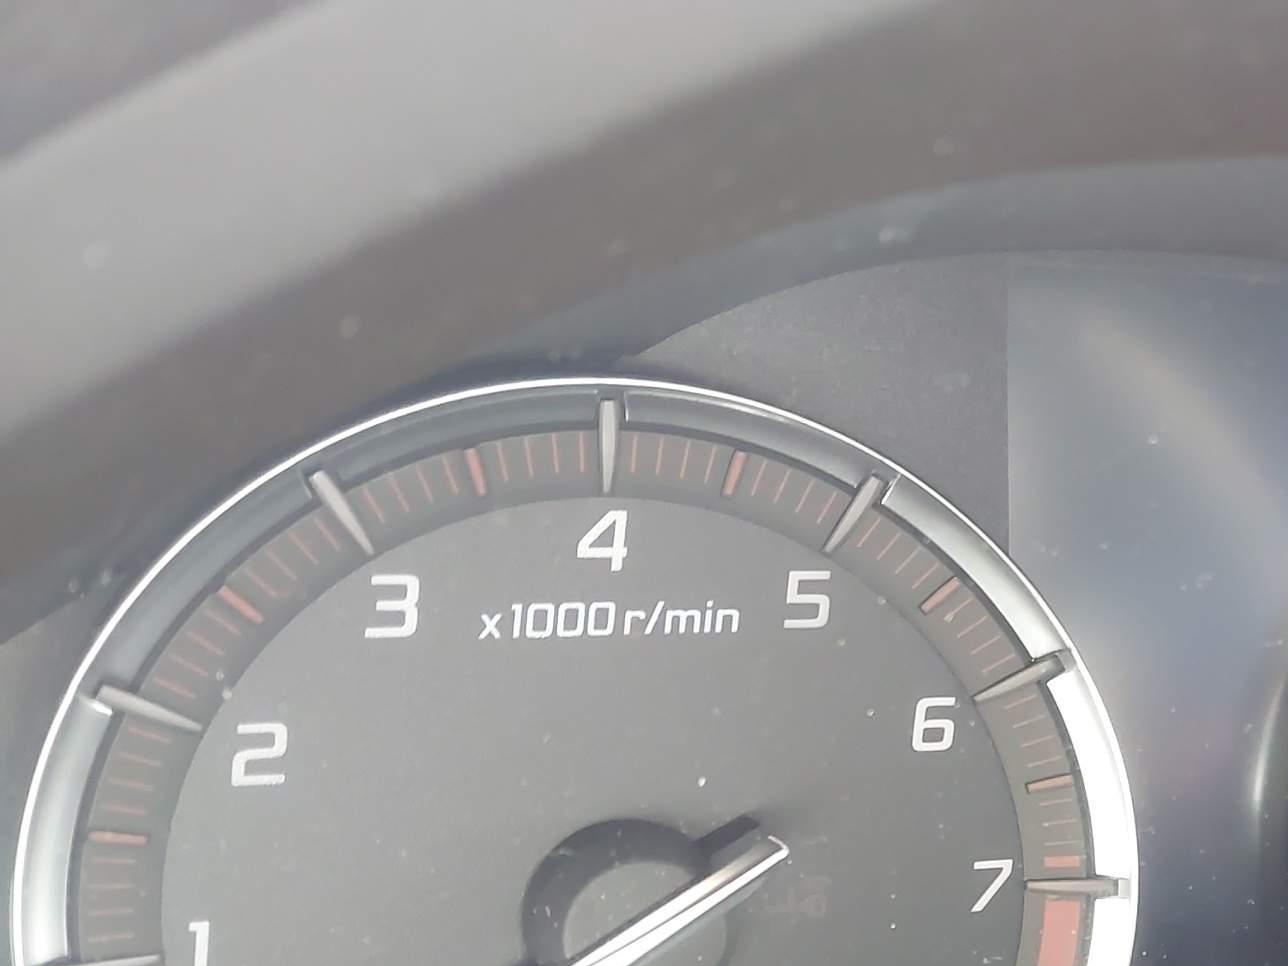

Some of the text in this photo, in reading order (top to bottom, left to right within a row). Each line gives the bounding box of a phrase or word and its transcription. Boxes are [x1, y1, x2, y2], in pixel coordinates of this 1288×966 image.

[576, 510, 629, 571] 4
[364, 573, 421, 639] 3
[622, 598, 741, 637] r/min
[783, 569, 831, 630] 5
[230, 722, 289, 787] 2
[911, 696, 957, 752] 6
[969, 859, 1013, 913] 7
